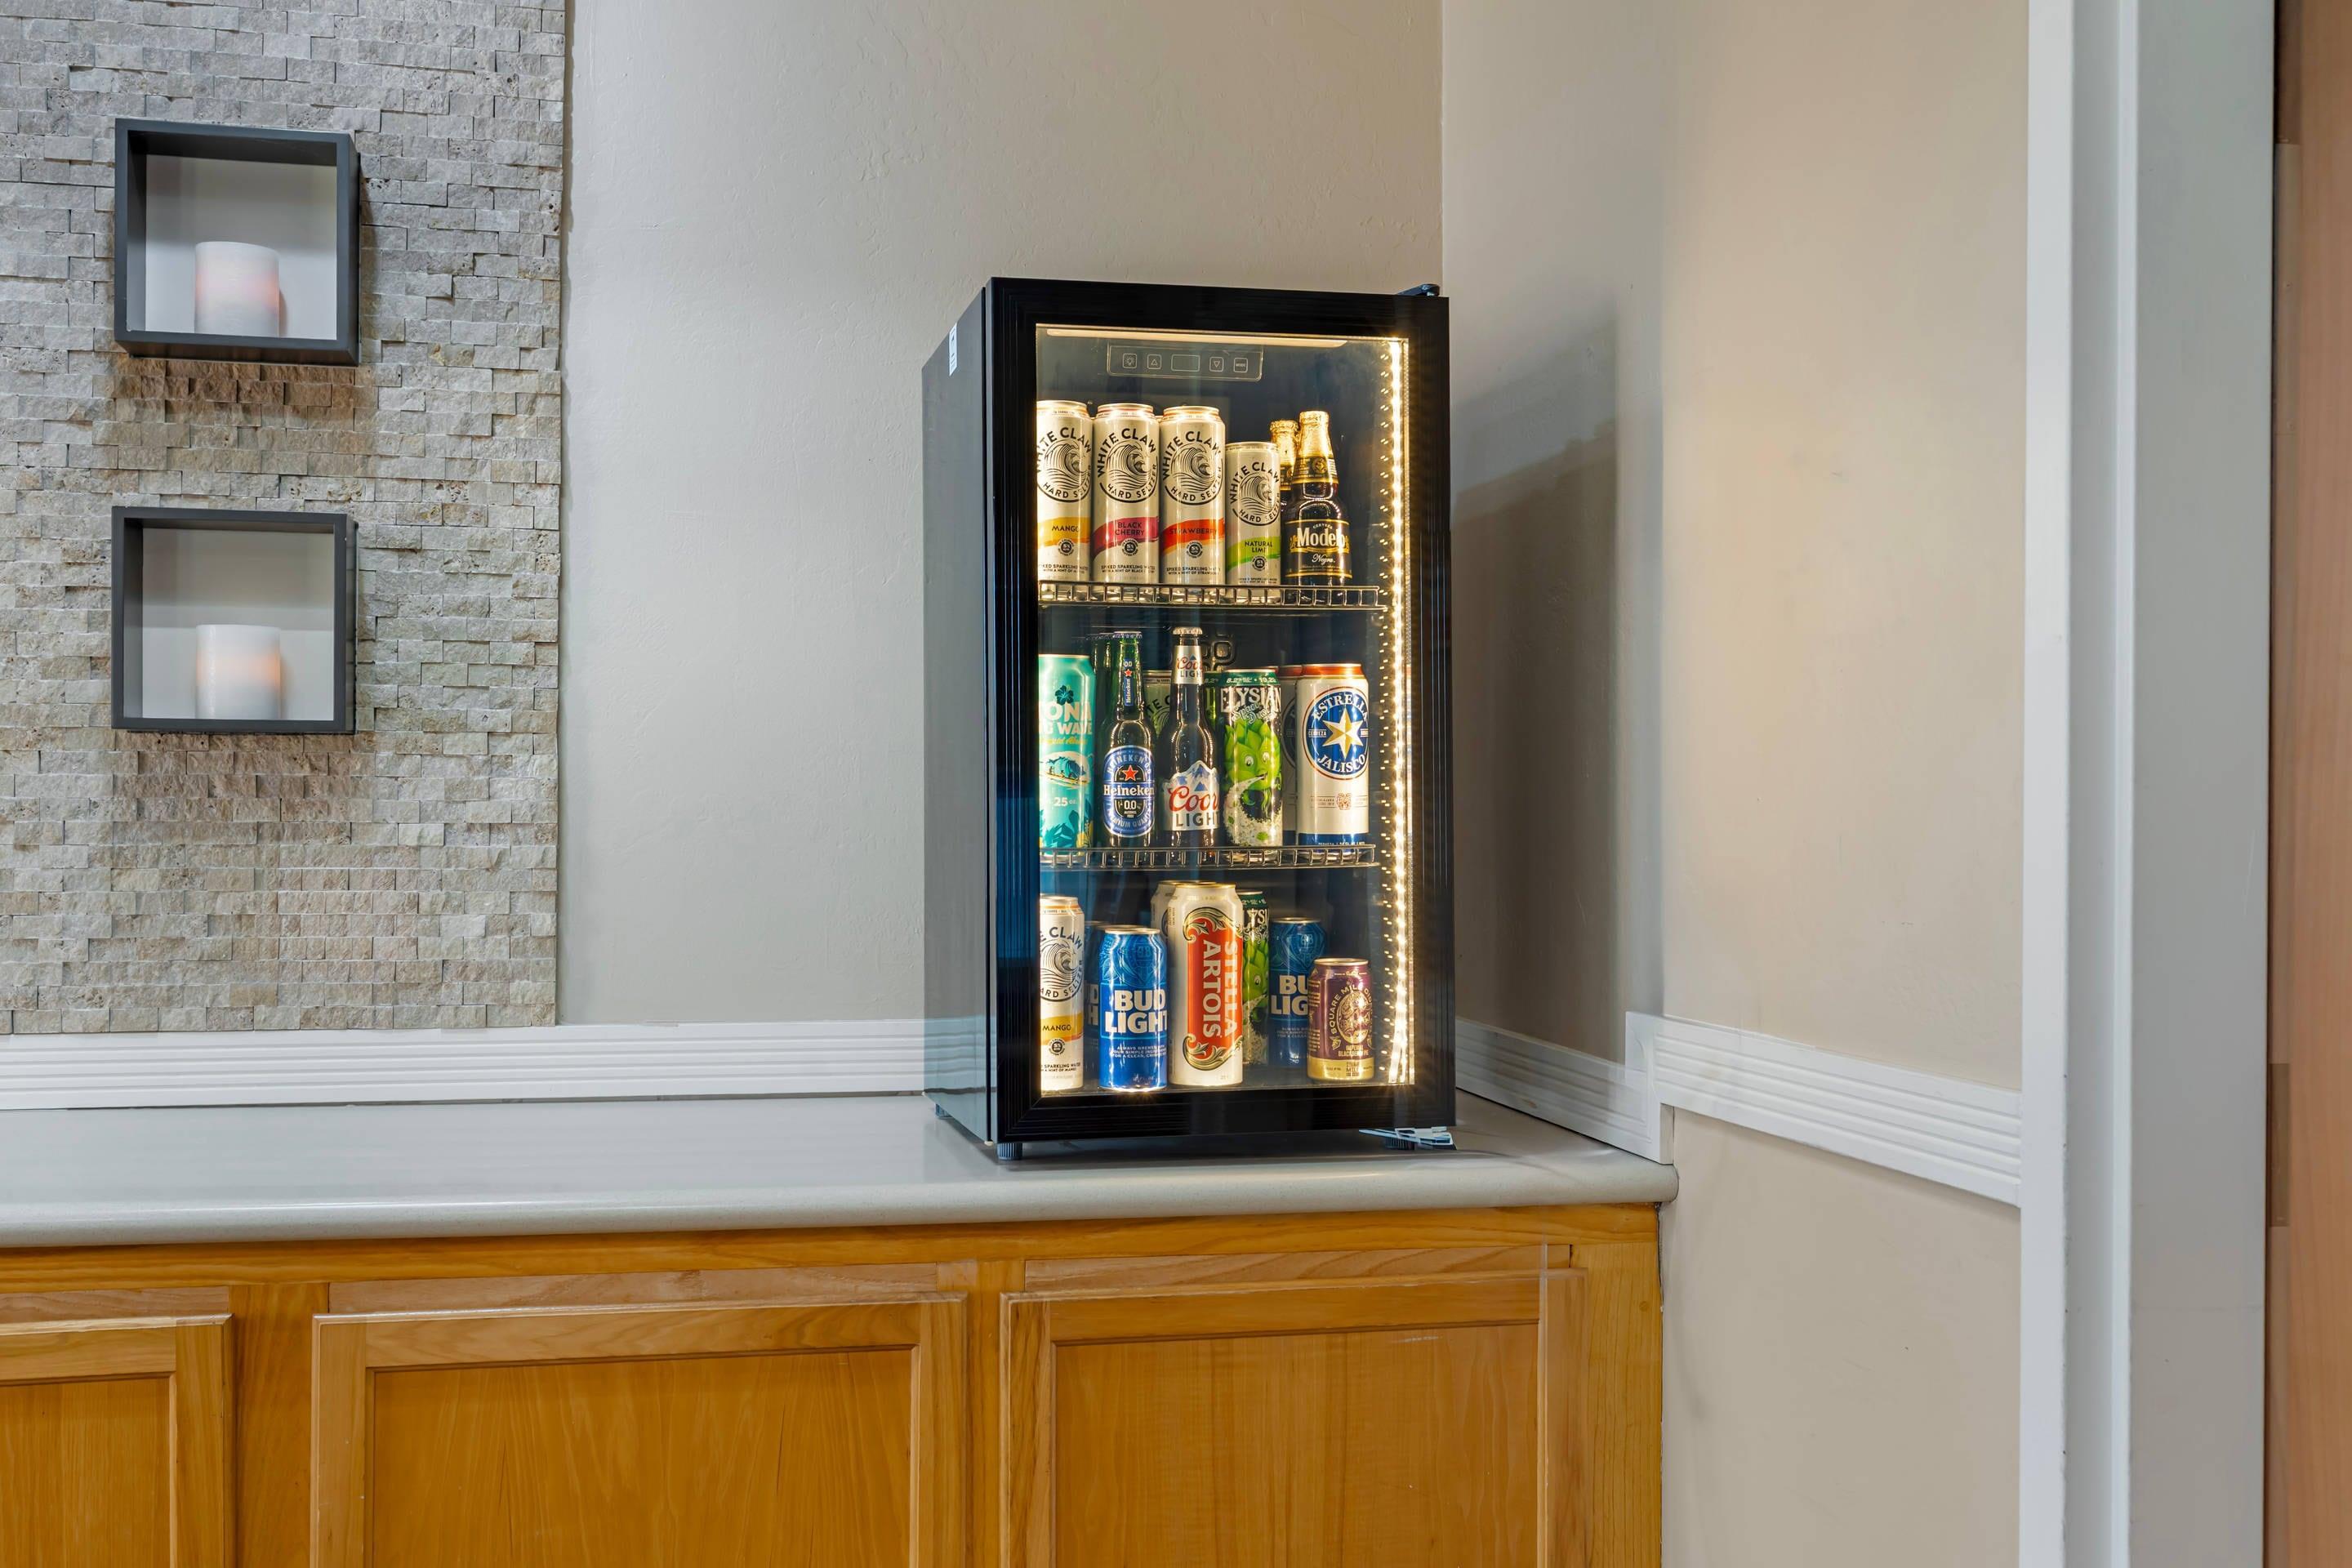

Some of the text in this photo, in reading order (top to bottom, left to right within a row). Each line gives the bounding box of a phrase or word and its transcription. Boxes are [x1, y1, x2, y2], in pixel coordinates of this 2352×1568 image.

[1097, 428, 1156, 478] WHITE CLAW
[1162, 430, 1222, 481] WHITE CLAW
[1044, 482, 1069, 498] HARD
[1107, 483, 1132, 499] HARD
[1170, 486, 1196, 501] HARD
[1229, 461, 1280, 505] WHITE CLAW
[1238, 509, 1262, 523] HARD
[1297, 527, 1346, 548] Modelo
[1221, 687, 1281, 713] ELYSIAN
[1312, 693, 1369, 722] ESTRELLA
[1041, 701, 1093, 721] ONA
[1317, 753, 1365, 773] JALISCO
[1103, 785, 1155, 796] Heineken
[1054, 797, 1068, 807] 25
[1124, 800, 1137, 811] 0.0
[1049, 926, 1082, 950] CLAW
[1040, 987, 1059, 998] ARD
[1203, 939, 1222, 1038] ARTOIS
[1224, 940, 1238, 1037] STELLA
[1279, 974, 1308, 995] BU
[1114, 989, 1166, 1012] BUD
[1271, 995, 1308, 1016] LIG
[1329, 993, 1342, 1035] SQUARE
[1340, 982, 1363, 995] MIL
[1104, 1009, 1168, 1034] LIGHT
